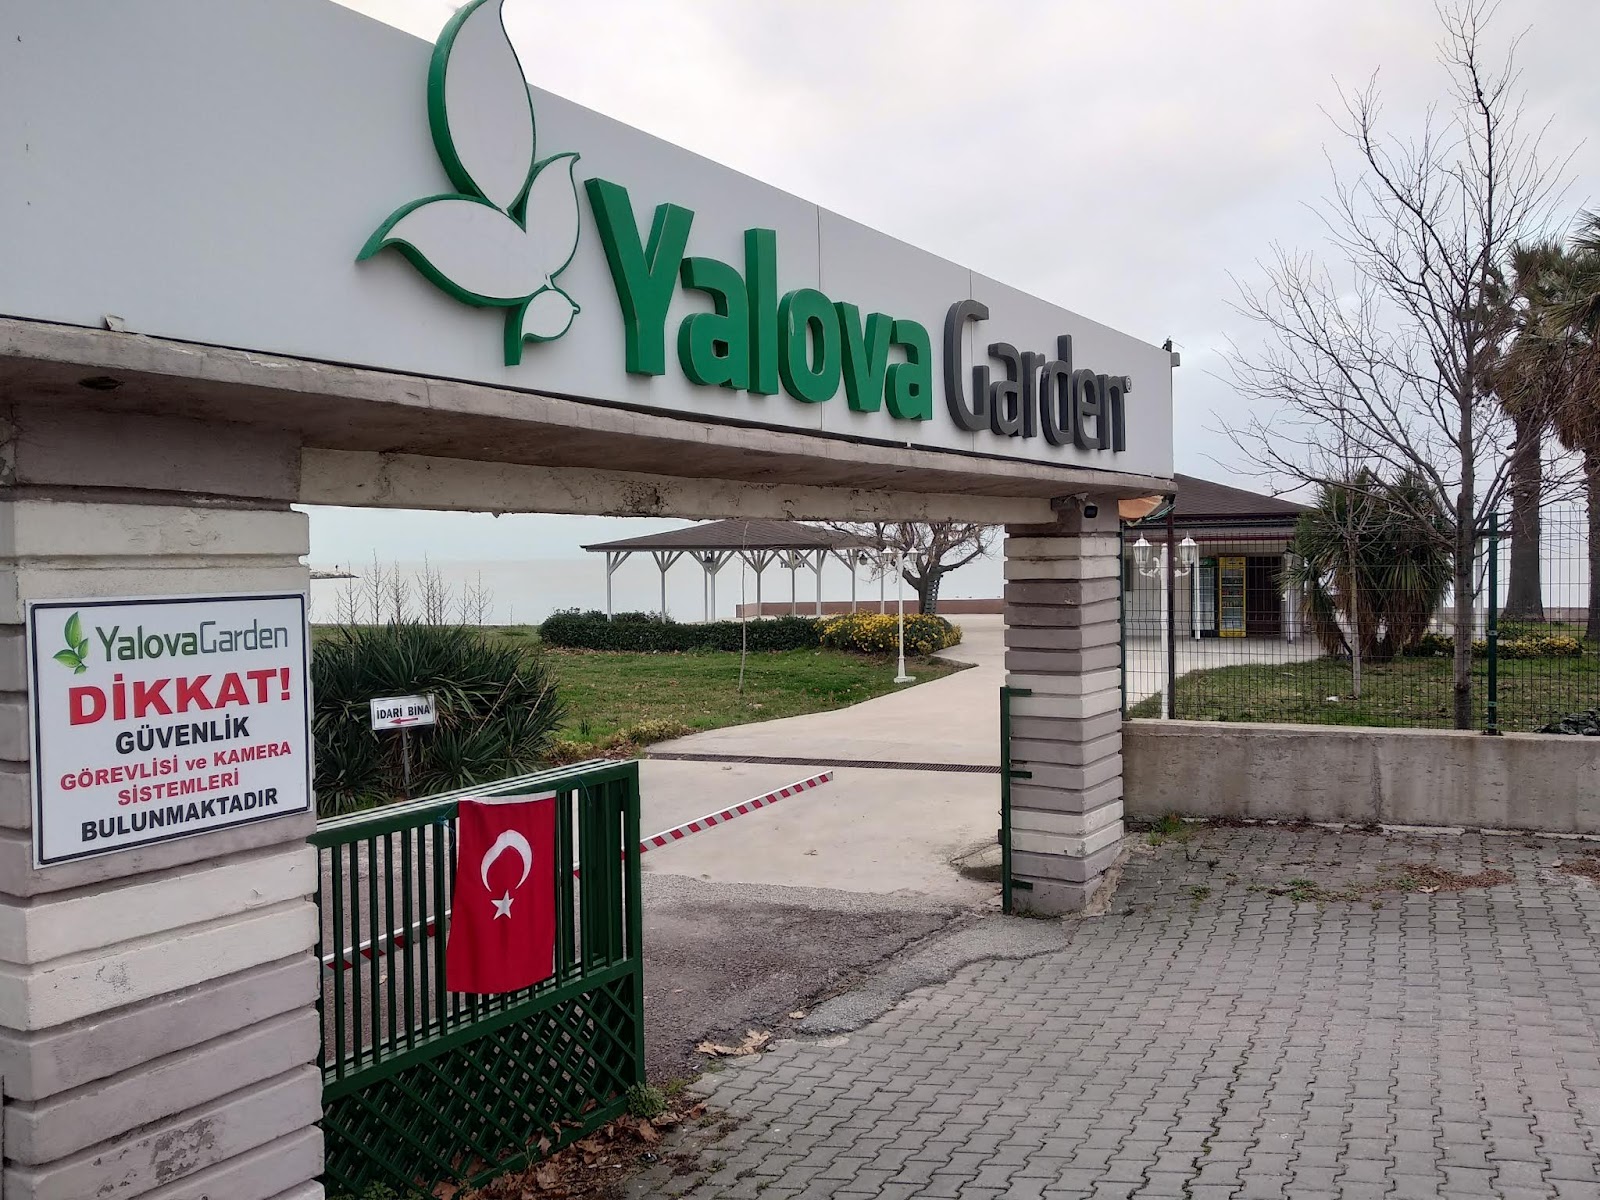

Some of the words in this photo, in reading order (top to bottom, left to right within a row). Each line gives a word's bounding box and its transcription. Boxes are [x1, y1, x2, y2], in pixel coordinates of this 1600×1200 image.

[584, 177, 933, 421] Yalova
[943, 299, 1126, 453] Garden
[95, 619, 288, 662] YalovaGarden
[68, 667, 291, 726] DİKKAT!
[376, 705, 403, 720] İDARİ
[408, 703, 430, 716] BİNA
[115, 716, 250, 755] GÜVENLİK
[60, 758, 179, 791] GÖREVLİSİ
[185, 756, 207, 770] ve
[213, 740, 292, 768] KAMERA
[118, 769, 240, 806] SİSTEMLERİ
[81, 787, 278, 842] BULUNMAKTADIR
